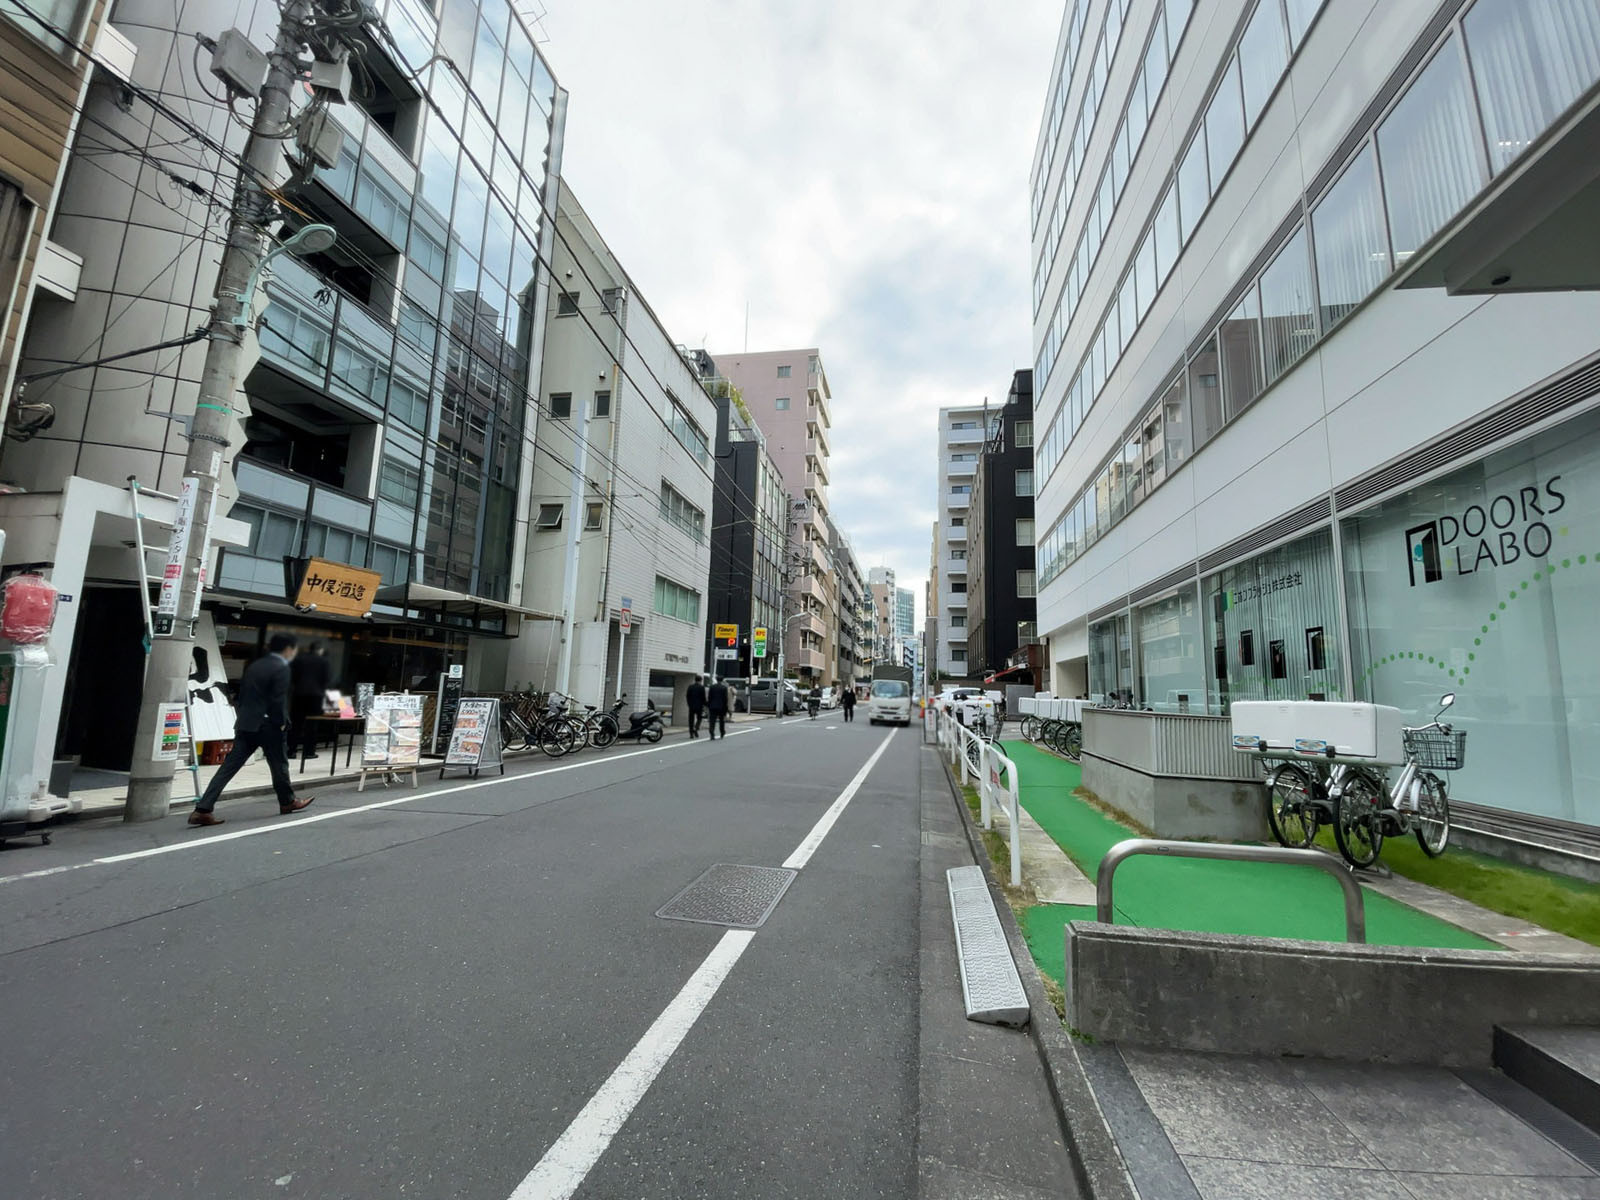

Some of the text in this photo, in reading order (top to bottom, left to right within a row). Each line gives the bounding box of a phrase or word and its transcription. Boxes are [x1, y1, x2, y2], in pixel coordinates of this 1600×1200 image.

[1439, 475, 1566, 546] DOORS
[1455, 521, 1552, 576] LABO
[307, 573, 366, 601] 中俣酒造
